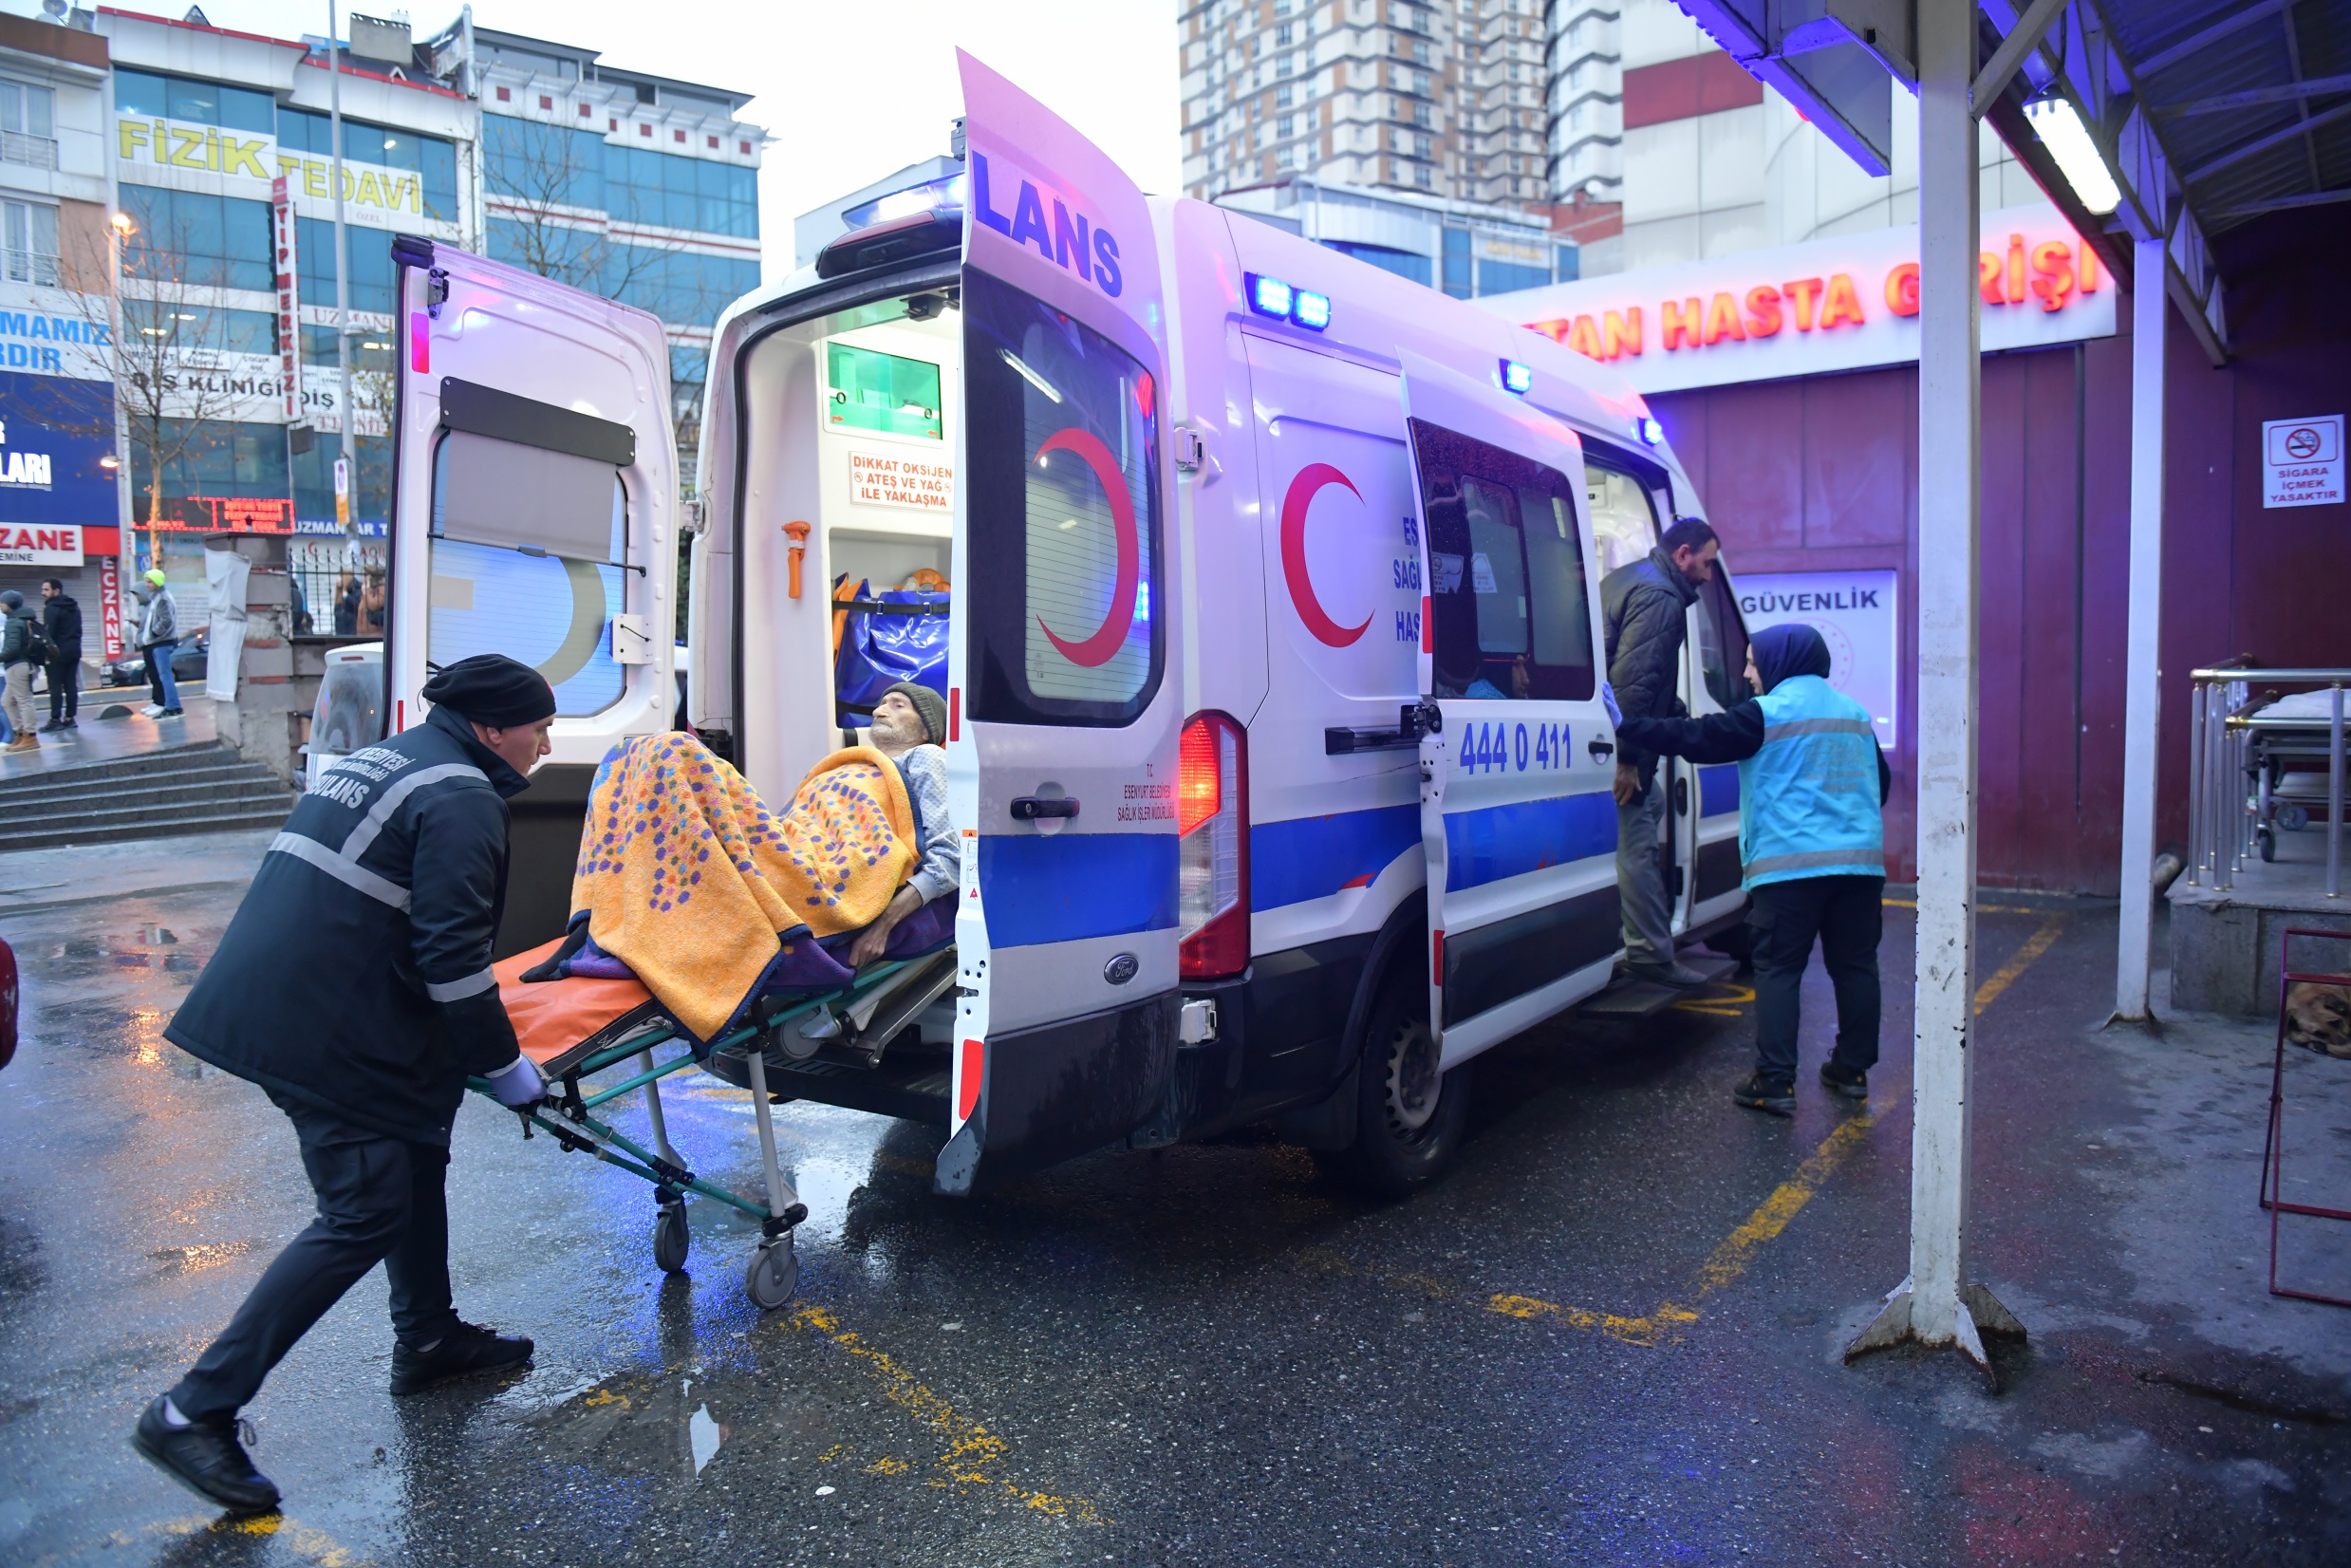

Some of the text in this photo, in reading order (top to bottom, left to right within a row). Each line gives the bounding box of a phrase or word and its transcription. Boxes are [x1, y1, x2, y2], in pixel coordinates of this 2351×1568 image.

[119, 119, 420, 215] FİZİK TEDAVİ
[356, 211, 383, 224] ÖZEL
[972, 149, 1123, 299] LANS
[277, 208, 289, 265] TIP
[1661, 273, 1865, 350] HASTA
[1884, 233, 2097, 313] GRİŞİ
[0, 311, 112, 346] MAMIZ
[0, 343, 61, 371] DIR
[853, 456, 952, 478] DİKKAT OKSİJEN
[2278, 467, 2329, 478] SİGARA
[867, 473, 942, 492] ATEŞ VE YAĞ
[2282, 479, 2325, 491] İÇMEK
[861, 487, 947, 508] İLE YAKLAŞMA
[2270, 491, 2338, 502] YASAKTIR
[294, 521, 375, 535] UZMANAR
[102, 555, 121, 655] ECZANE
[1741, 587, 1878, 614] GÜVENLİK
[1460, 722, 1571, 775] 444 0 411
[1124, 784, 1148, 799] ESENYURT
[1117, 803, 1137, 822] SAĞLIK
[1115, 960, 1134, 979] Ford
